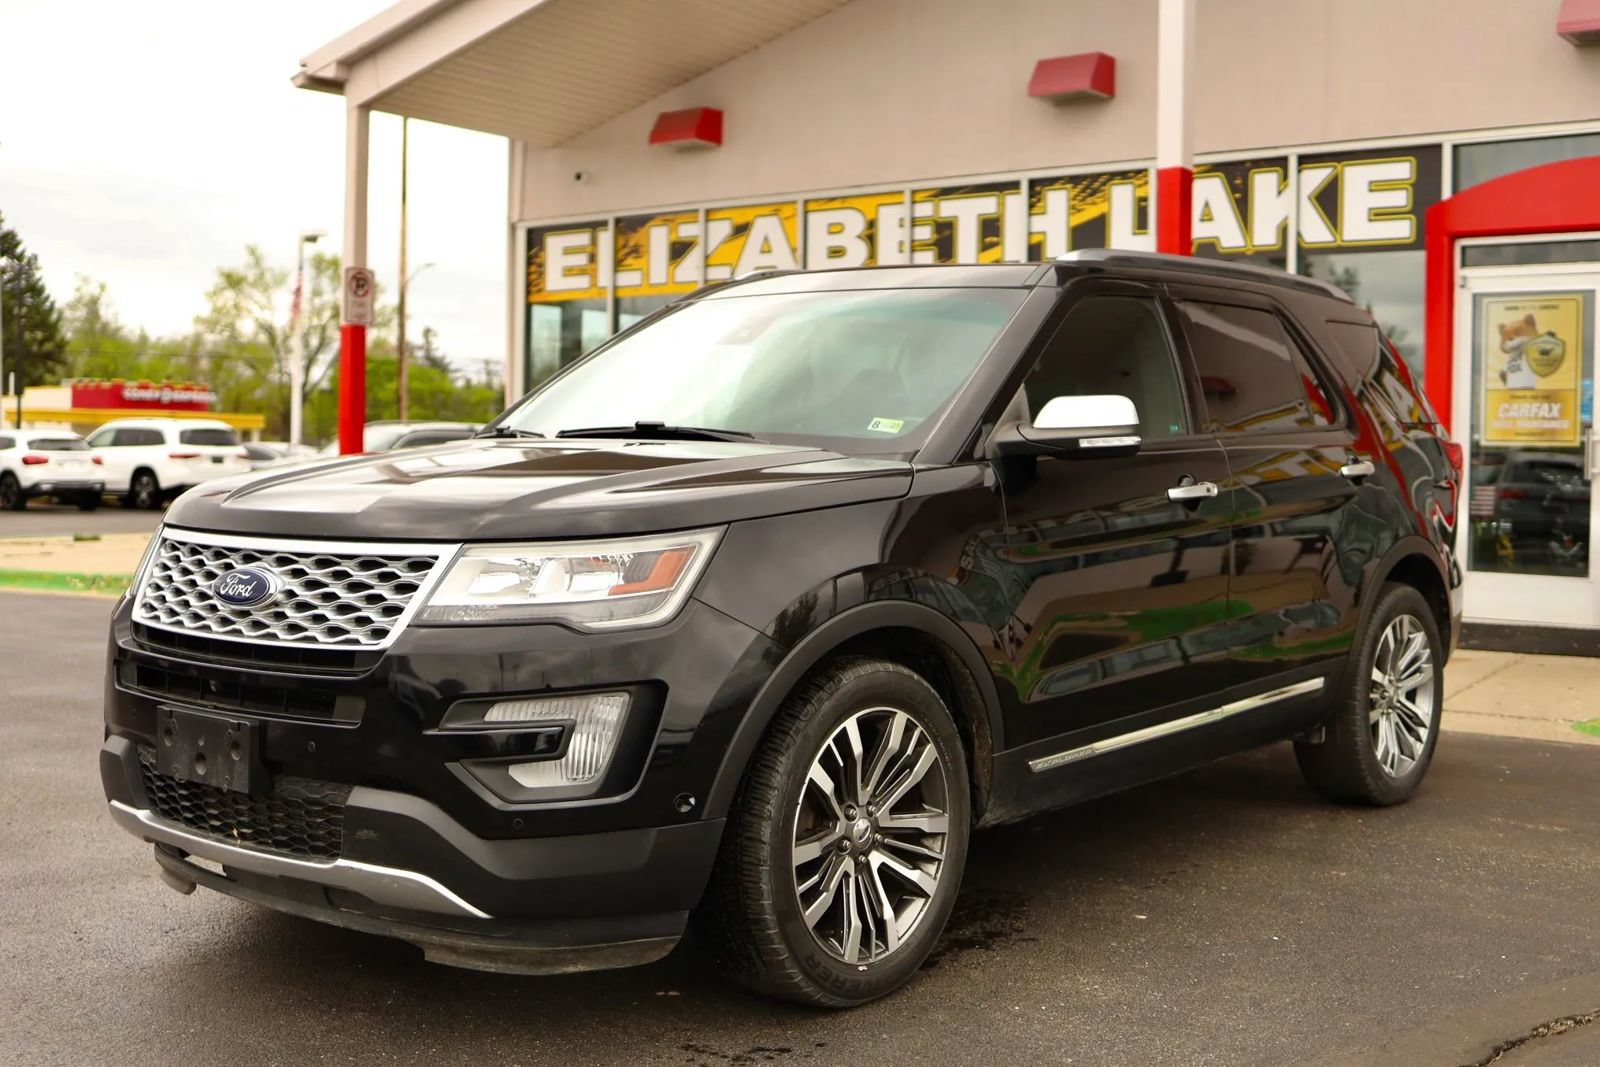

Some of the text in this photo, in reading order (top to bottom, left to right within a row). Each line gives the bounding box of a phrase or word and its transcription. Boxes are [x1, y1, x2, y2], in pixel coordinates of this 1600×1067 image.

[543, 157, 1417, 291] ELIZABETH LAKE
[1498, 402, 1561, 418] CARFAX
[871, 420, 881, 429] 8
[220, 572, 257, 597] Ford
